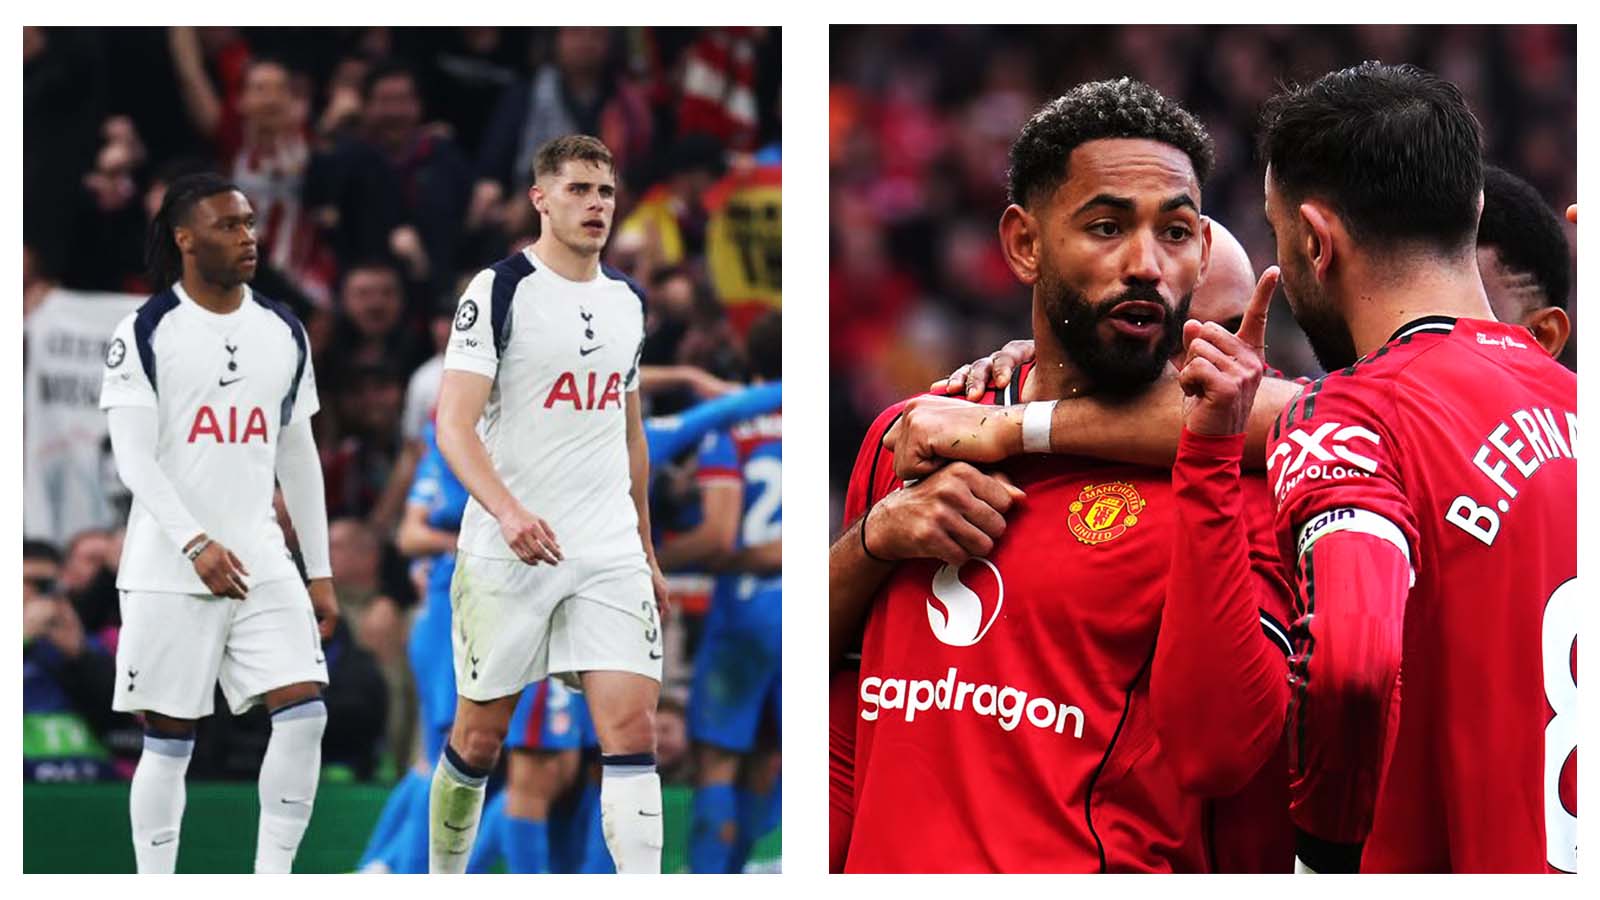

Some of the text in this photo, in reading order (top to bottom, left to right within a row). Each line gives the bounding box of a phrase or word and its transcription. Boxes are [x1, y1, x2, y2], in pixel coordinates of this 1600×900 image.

[543, 371, 621, 410] AIA
[187, 405, 268, 443] AIA
[860, 667, 1085, 739] Sapdragon
